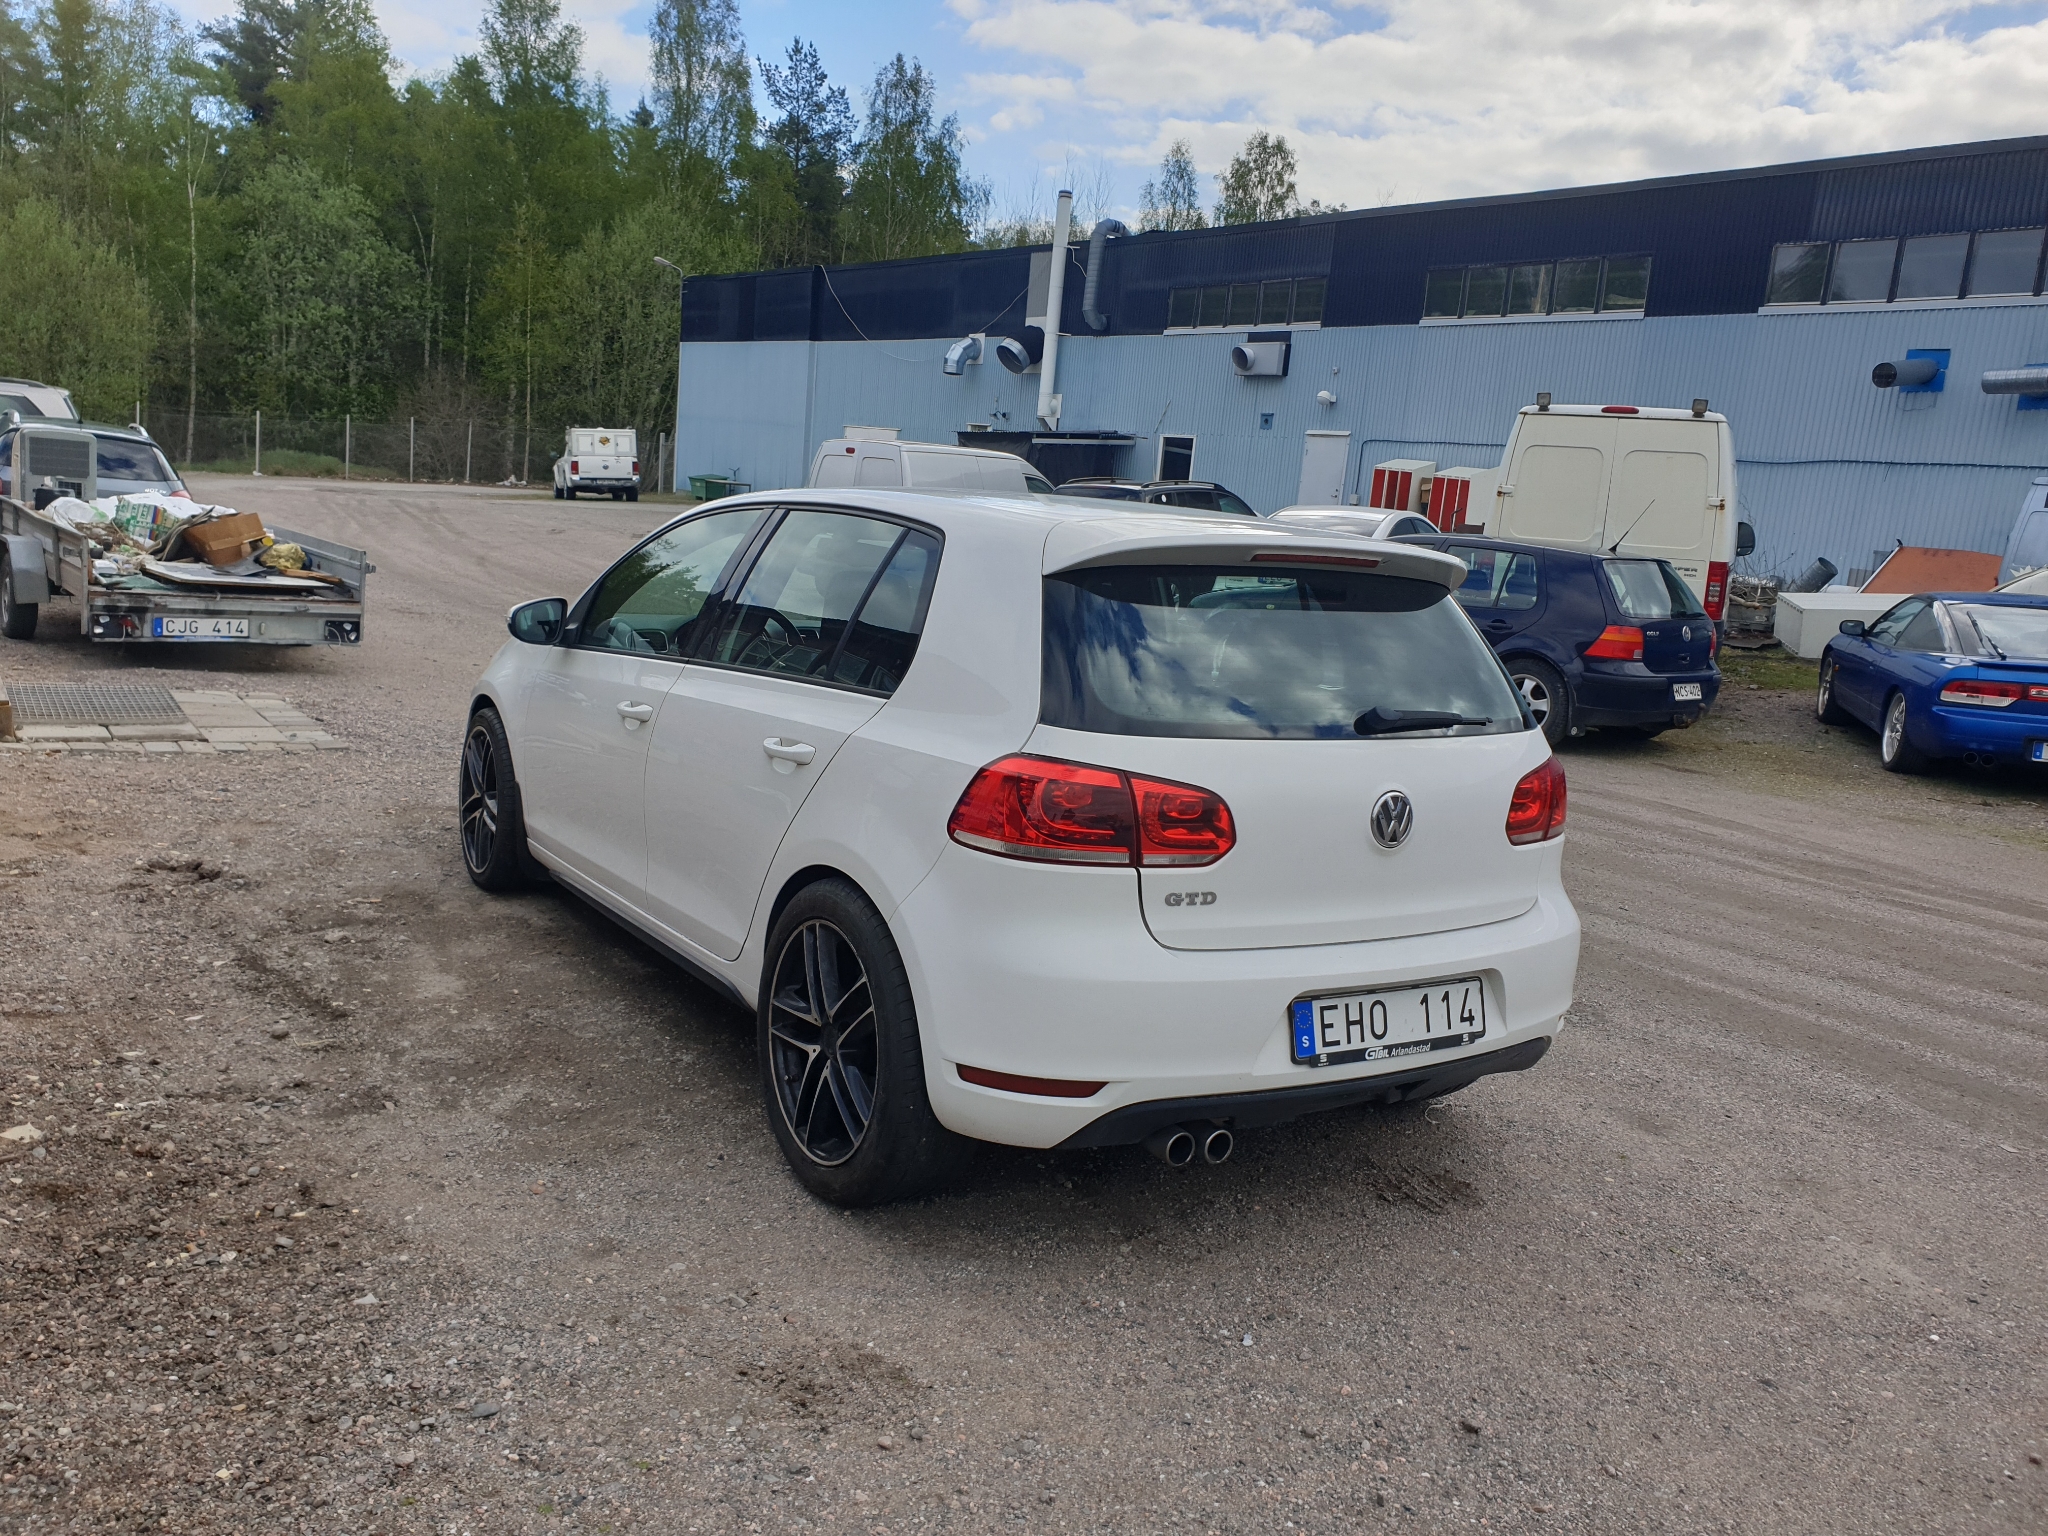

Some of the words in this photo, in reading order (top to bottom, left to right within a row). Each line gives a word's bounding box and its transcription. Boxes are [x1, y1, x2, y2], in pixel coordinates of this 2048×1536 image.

[165, 619, 199, 634] CJG
[212, 620, 244, 634] 414
[1164, 891, 1217, 906] GTD
[1319, 999, 1388, 1048] EHO
[1419, 987, 1475, 1033] 114
[1302, 1035, 1309, 1047] S
[1391, 1042, 1431, 1057] Arlandastad
